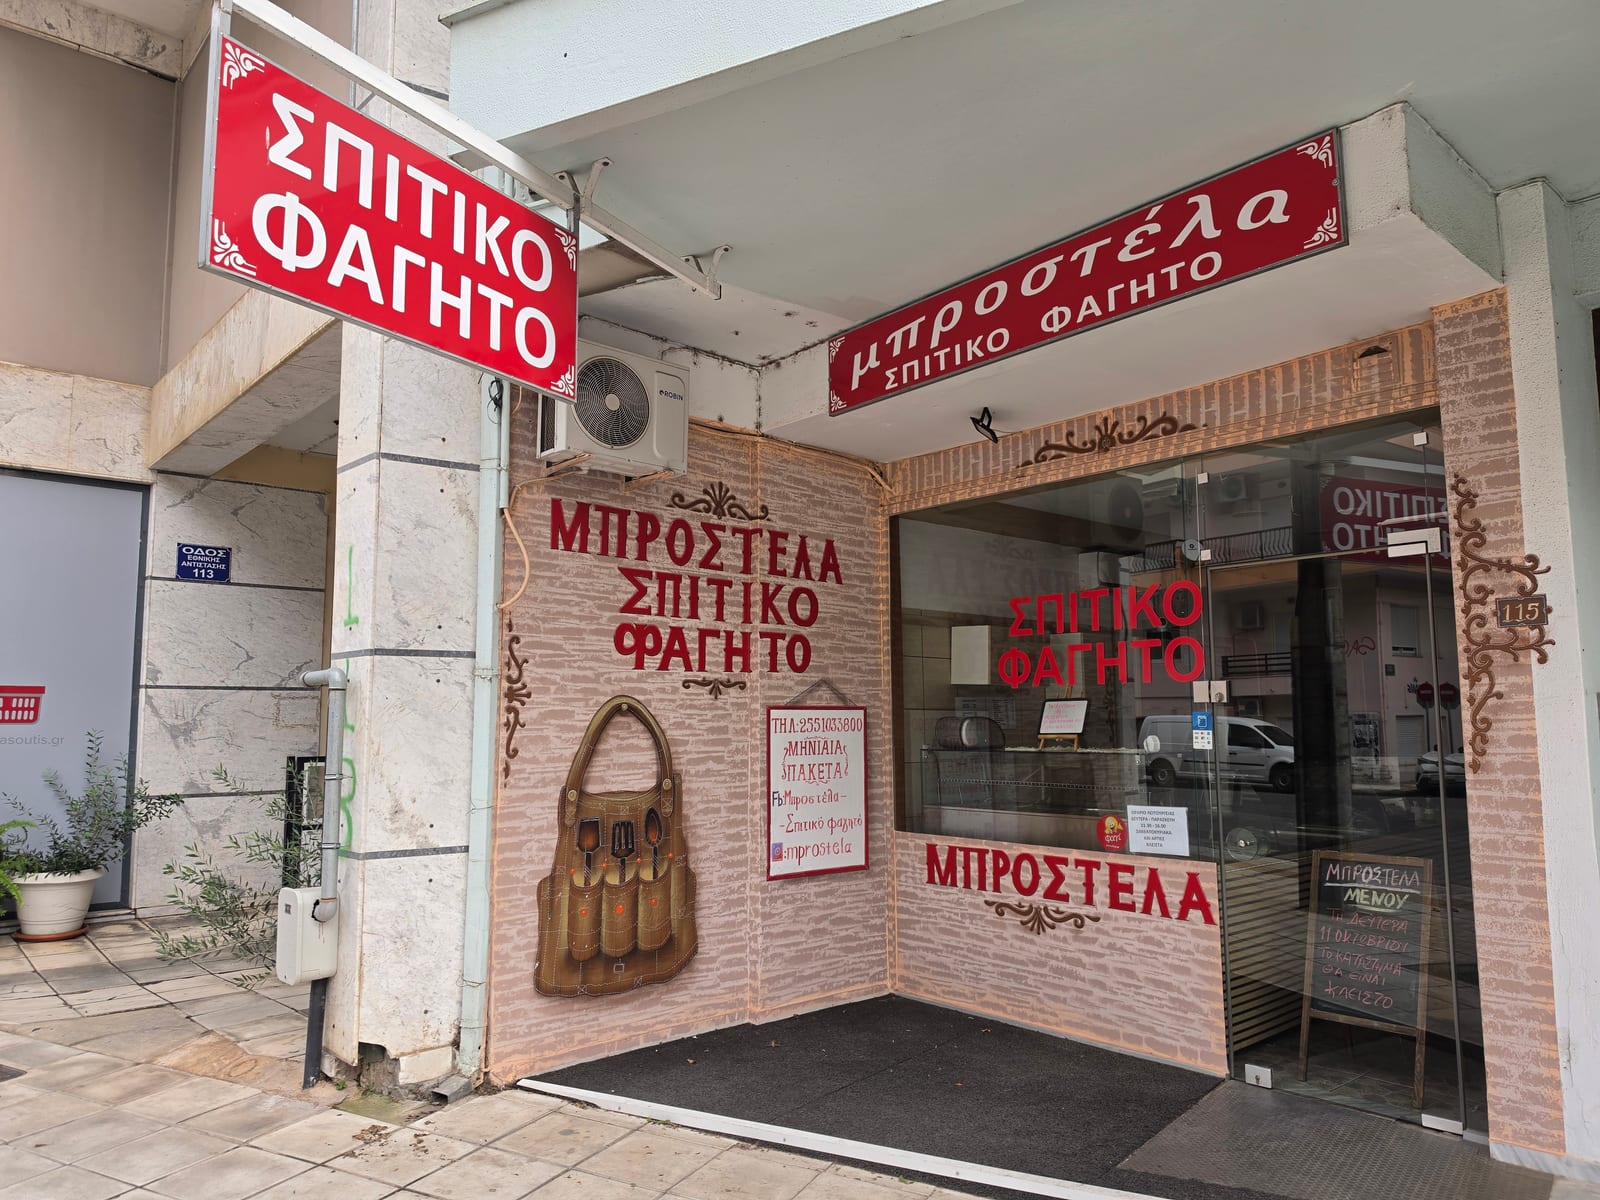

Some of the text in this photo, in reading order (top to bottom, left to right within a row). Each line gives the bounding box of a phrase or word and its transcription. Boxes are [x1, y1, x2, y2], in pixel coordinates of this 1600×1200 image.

[267, 92, 552, 292] ΣΠΙΤΙΚΟ
[252, 191, 555, 369] ΦΑΓΗΤΟ
[851, 188, 1290, 391] μπροστέλα
[884, 251, 1222, 390] ΣΠΙΤΙΚΟ ΦΑΓΗΤΟ
[182, 546, 226, 558] ΟΔΟΣ
[187, 555, 221, 563] ΕΘΝΙΚΗΣ
[550, 498, 843, 585] ΜΠΡΟΣΤΕΛΑ
[181, 561, 226, 570] ΑΝΤΙΣΤΑΣΗΣ
[193, 568, 214, 579] 113
[617, 566, 819, 627] ΣΠΙΤΙΚΟ
[1008, 580, 1204, 637] ΣΠΙΤΙΚΟ
[1502, 602, 1540, 623] 115
[613, 622, 812, 674] ΦΑΓΗΤΟ
[998, 635, 1206, 689] ΦΑΓΗΤΟ
[787, 739, 844, 757] ΜΗΝΙΑΙΑ
[787, 762, 843, 782] ΠΑΚΕΤΑ
[925, 843, 1218, 926] ΜΠΡΟΣΤΕΛΑ
[1325, 863, 1420, 886] ΜΠΡΟΣΤΕΛΑ
[1344, 887, 1410, 910] ΜΕΝΟΥ
[1324, 979, 1393, 1009] ΚΛΕΙΣΤΟ
